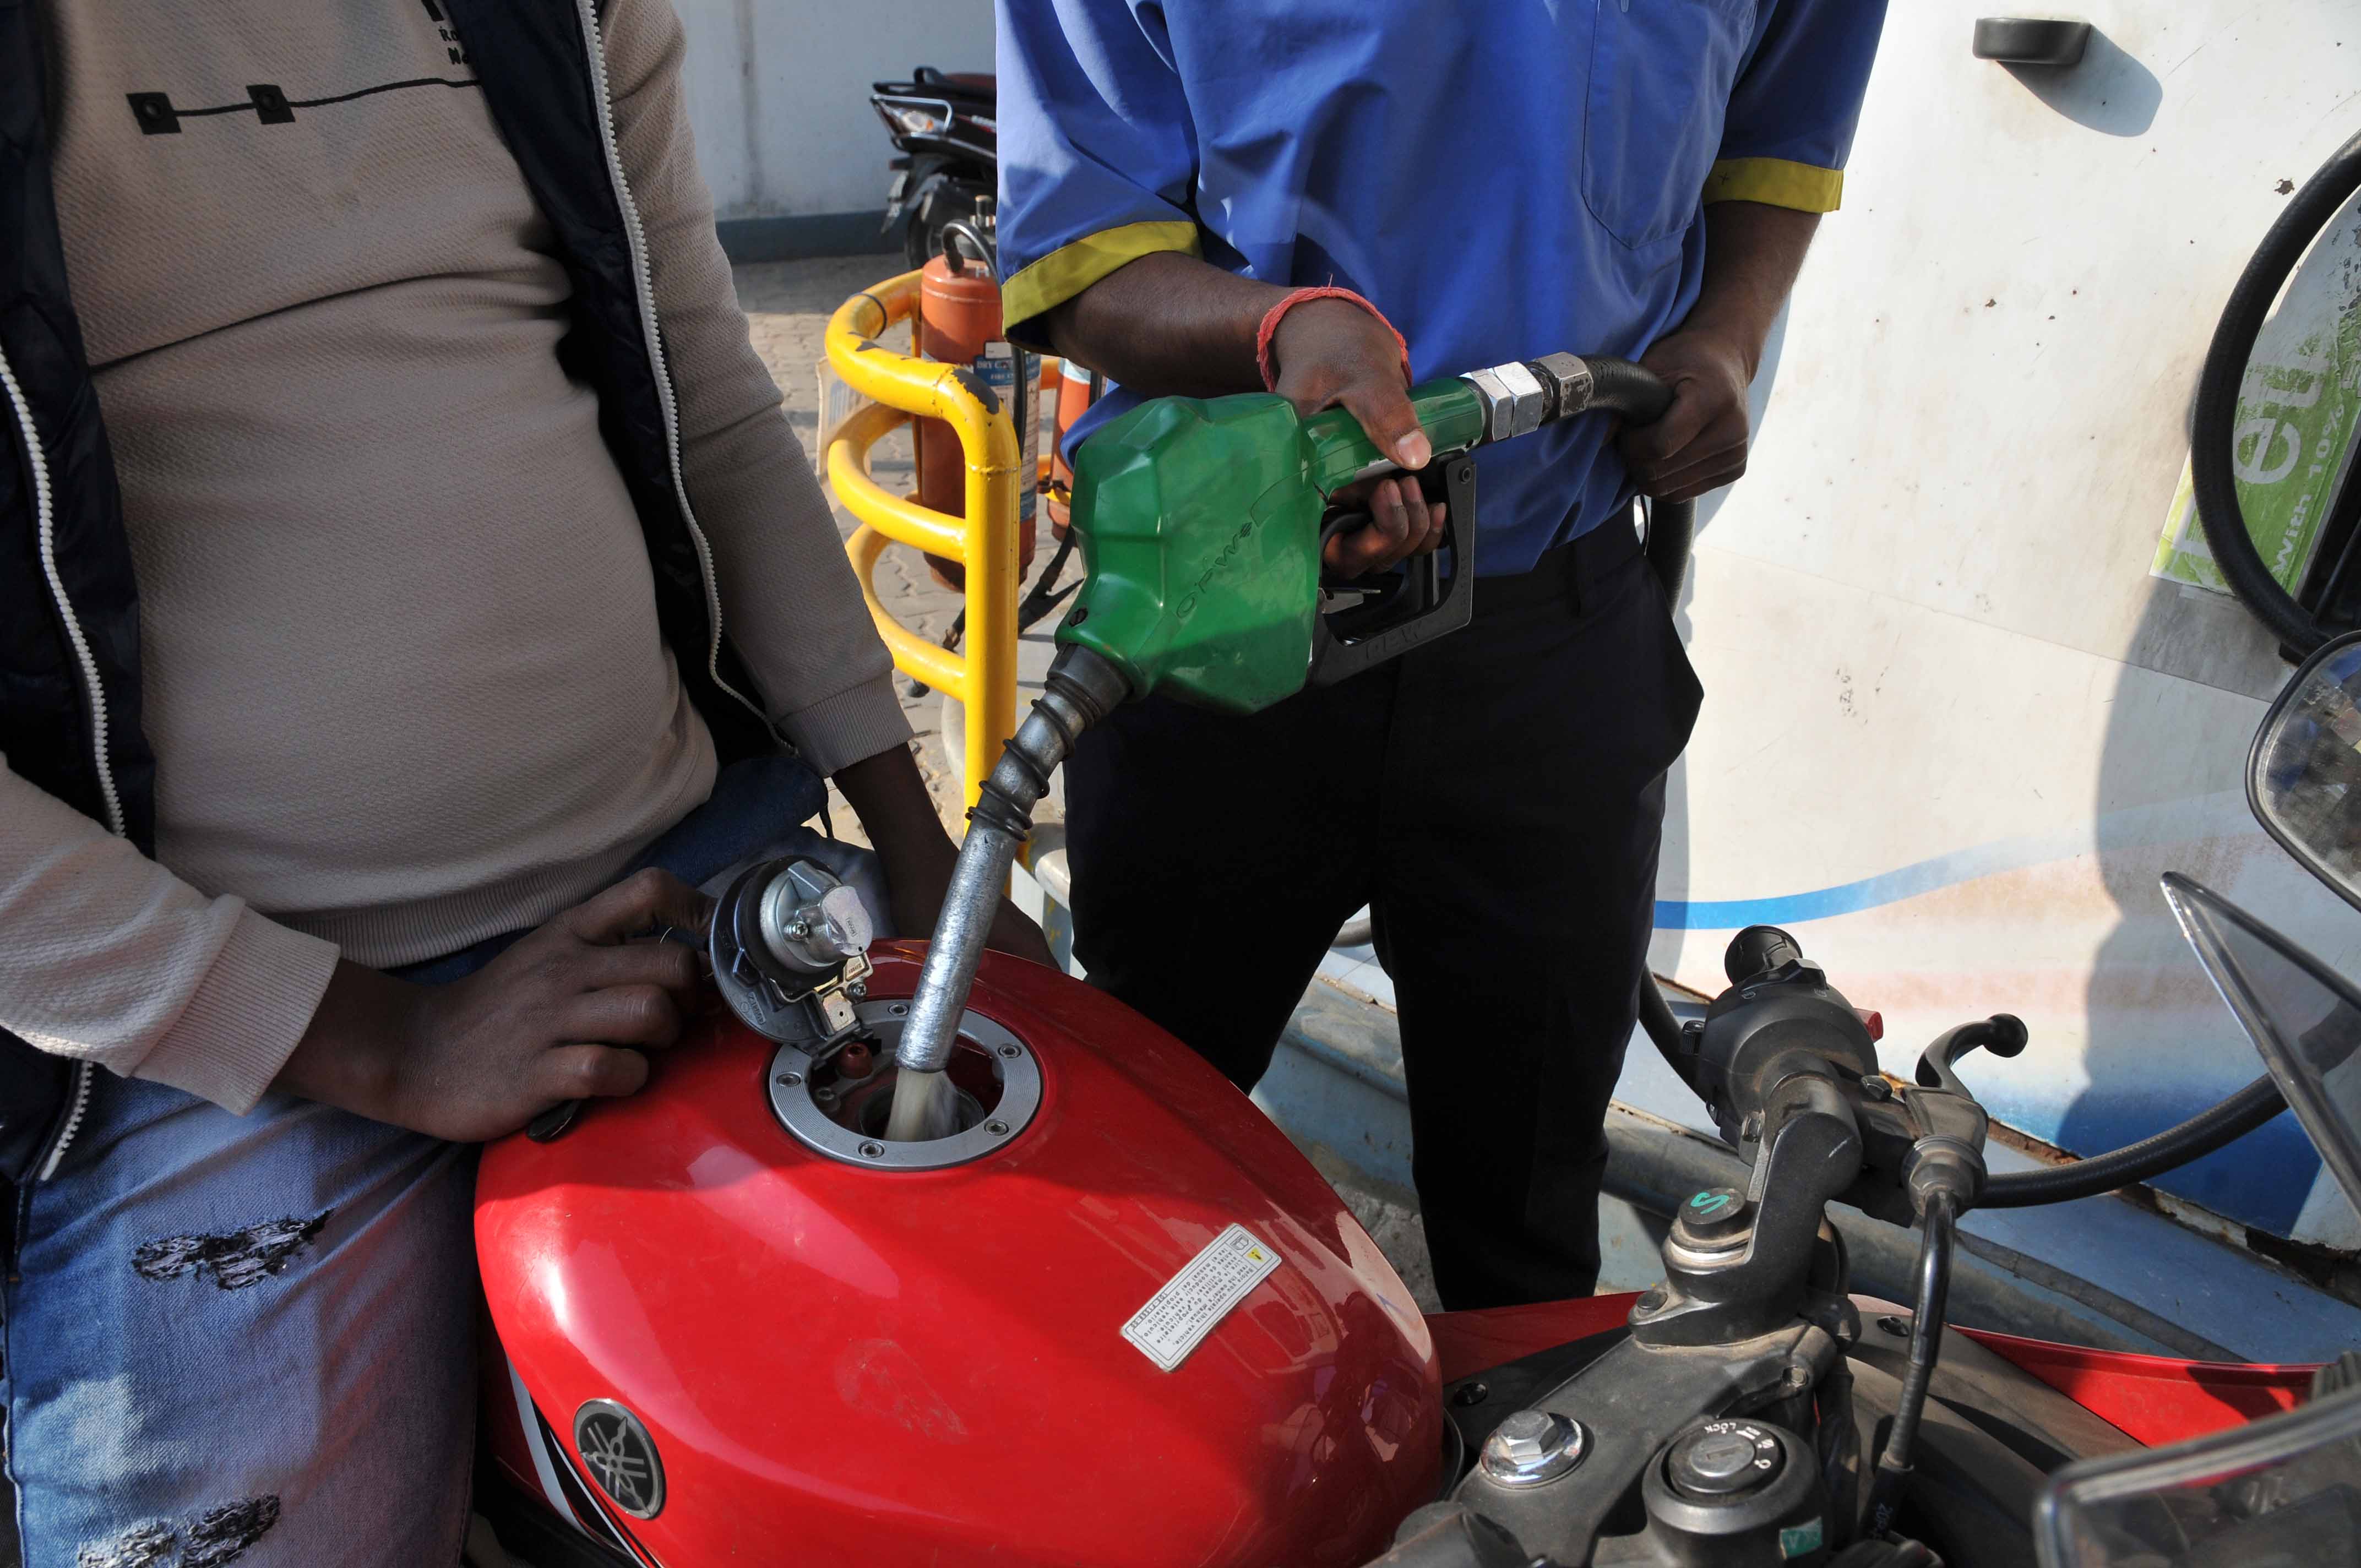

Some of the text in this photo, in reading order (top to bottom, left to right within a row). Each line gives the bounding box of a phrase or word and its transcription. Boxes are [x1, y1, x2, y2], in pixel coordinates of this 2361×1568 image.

[2309, 404, 2345, 480] 10%
[1180, 1280, 1192, 1292] del
[1183, 1273, 1210, 1297] conducir
[1225, 1282, 1238, 1293] you
[1169, 1297, 1185, 1311] este
[1206, 1292, 1228, 1313] operate
[1195, 1311, 1209, 1324] this
[1704, 1422, 1737, 1434] LOCK
